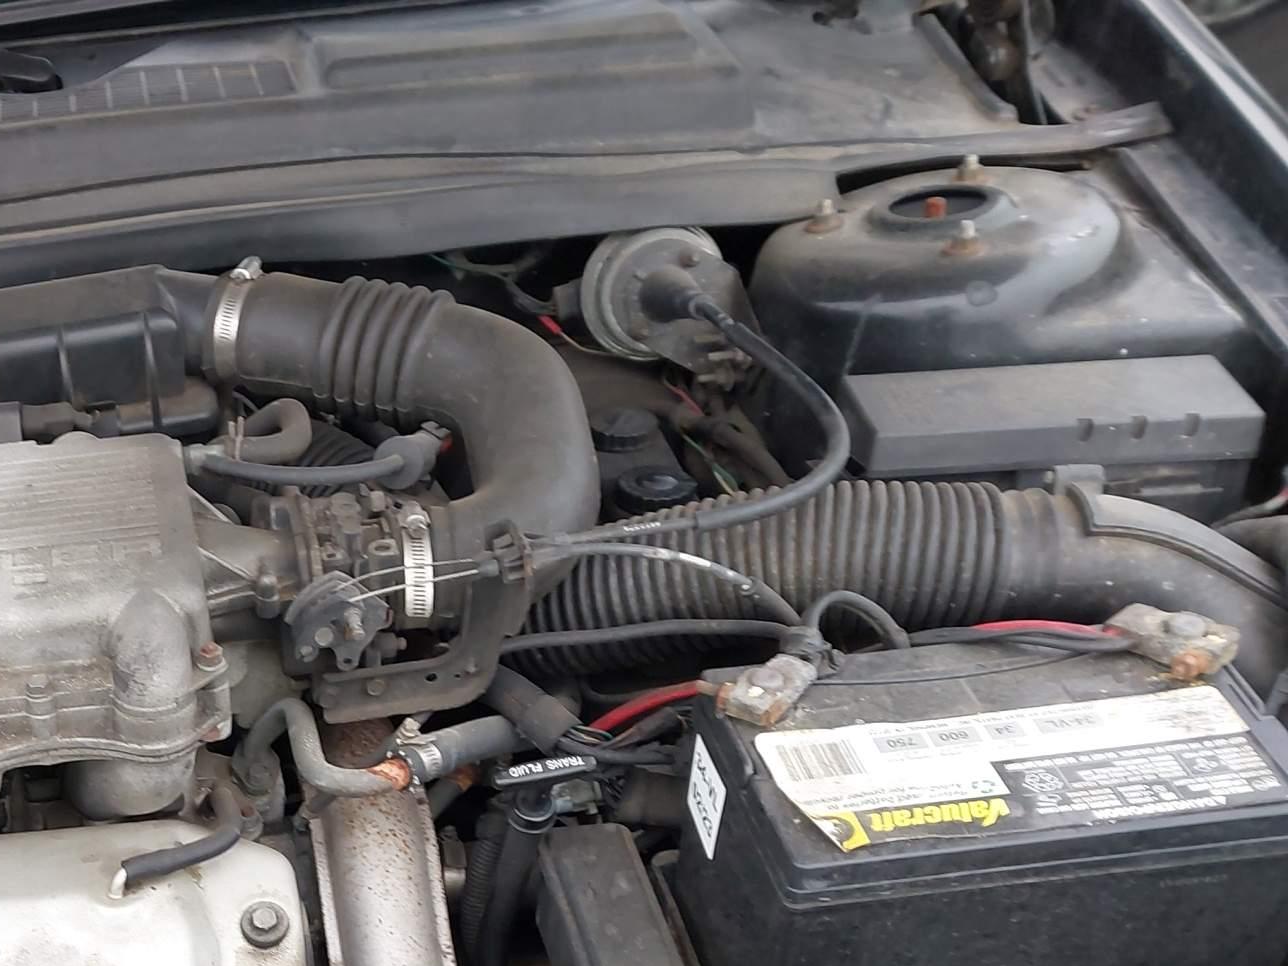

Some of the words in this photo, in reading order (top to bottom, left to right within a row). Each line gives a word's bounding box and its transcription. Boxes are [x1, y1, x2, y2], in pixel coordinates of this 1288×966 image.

[887, 737, 918, 748] 750
[939, 731, 969, 742] 600
[508, 762, 544, 777] FLUID
[546, 756, 585, 770] TRANS
[865, 797, 1010, 832] Valucraft
